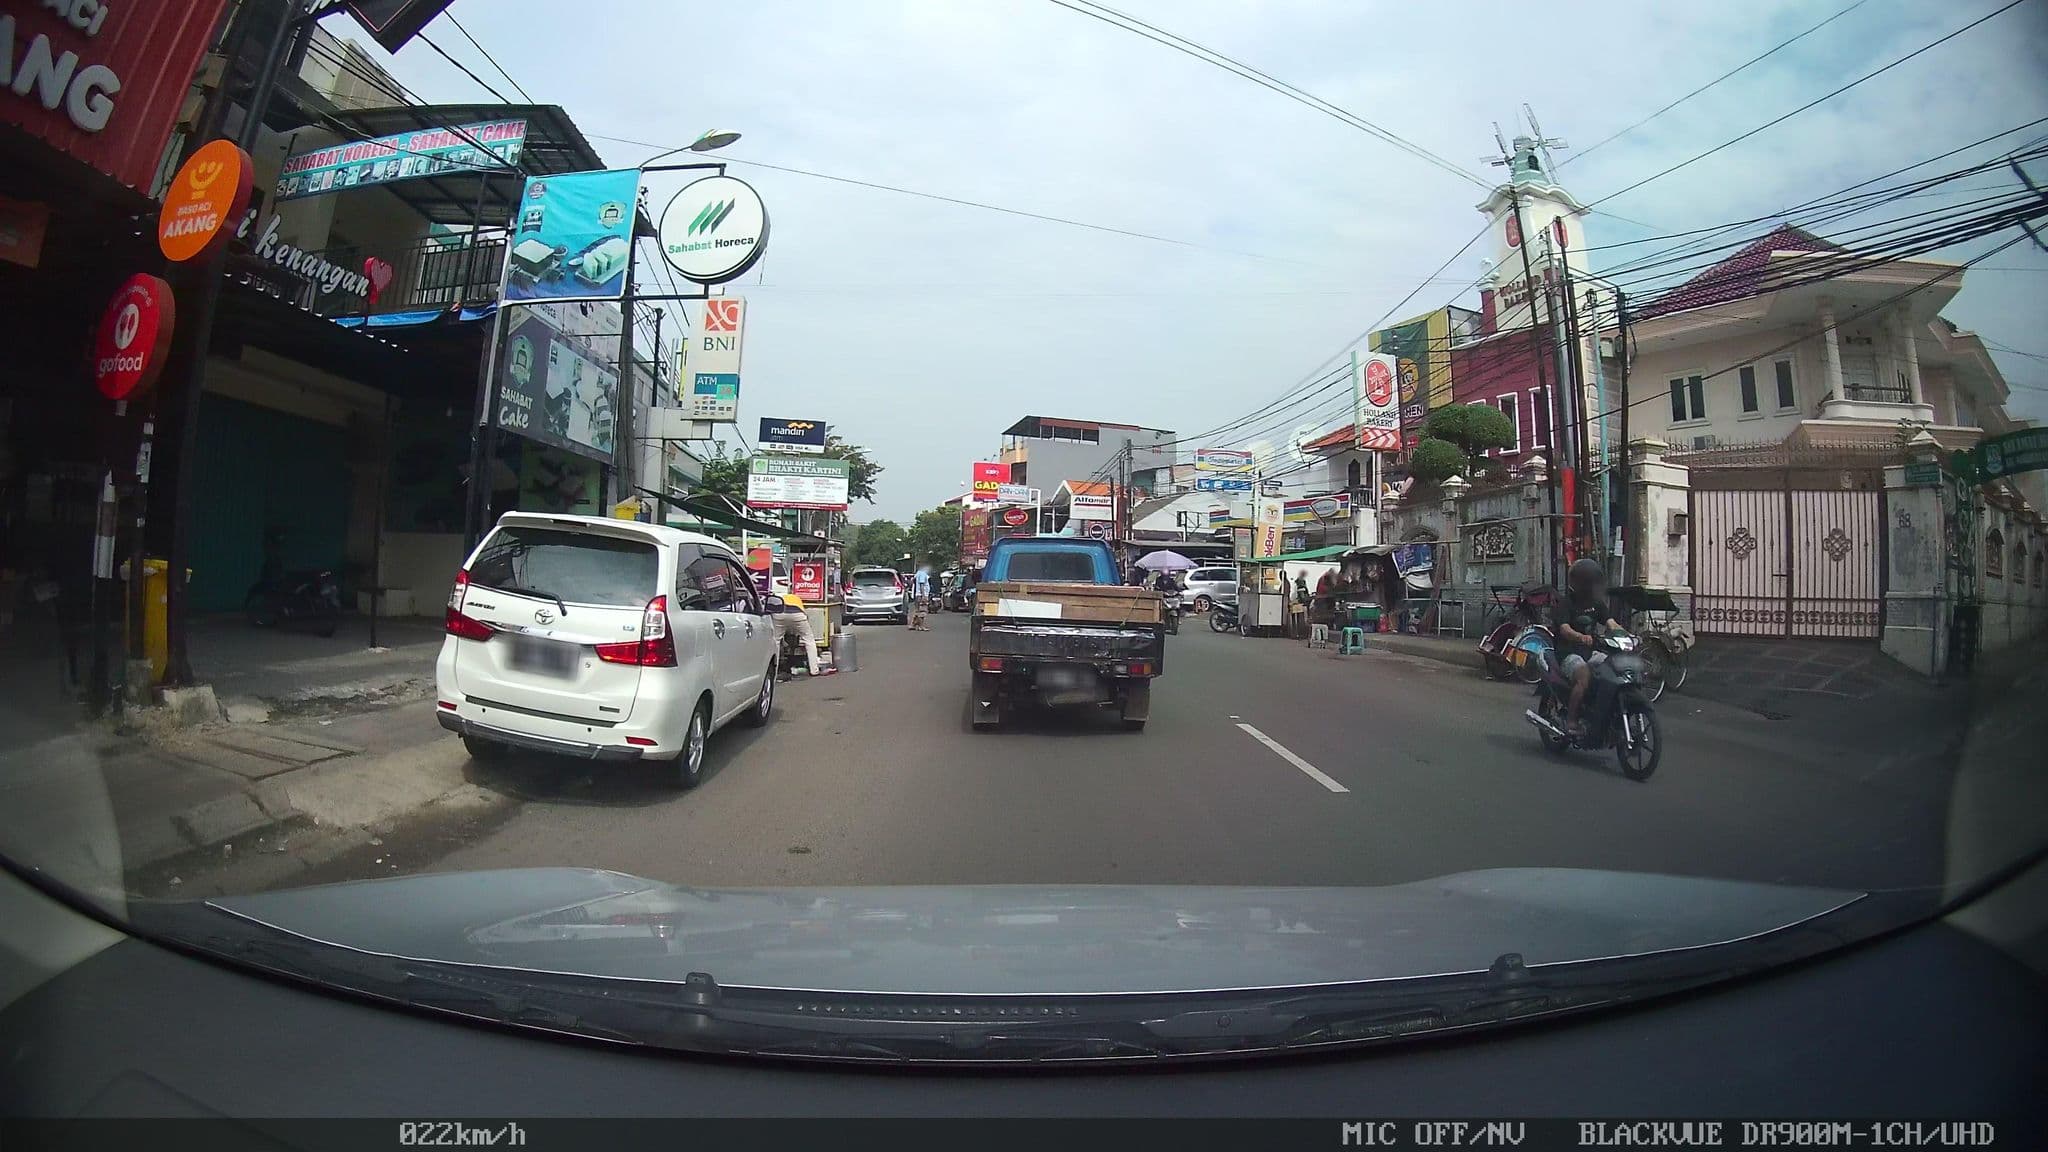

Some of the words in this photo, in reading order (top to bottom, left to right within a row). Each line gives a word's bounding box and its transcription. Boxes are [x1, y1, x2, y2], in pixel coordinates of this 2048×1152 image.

[283, 149, 341, 173] SAHABAT
[343, 139, 399, 161] HORECA
[481, 120, 526, 142] CAKE
[163, 213, 218, 239] AKANG
[667, 240, 713, 255] Sahabat
[714, 235, 755, 249] Horeca
[256, 214, 371, 298] kenangan
[702, 336, 736, 352] BNI
[98, 351, 144, 376] gofood
[696, 375, 718, 386] ATM
[500, 386, 534, 410] SAHABAT
[499, 407, 530, 429] Cake
[770, 426, 805, 437] mandiri
[769, 465, 803, 474] BHAKTI
[804, 467, 842, 475] KARTINI
[795, 582, 821, 590] gofood
